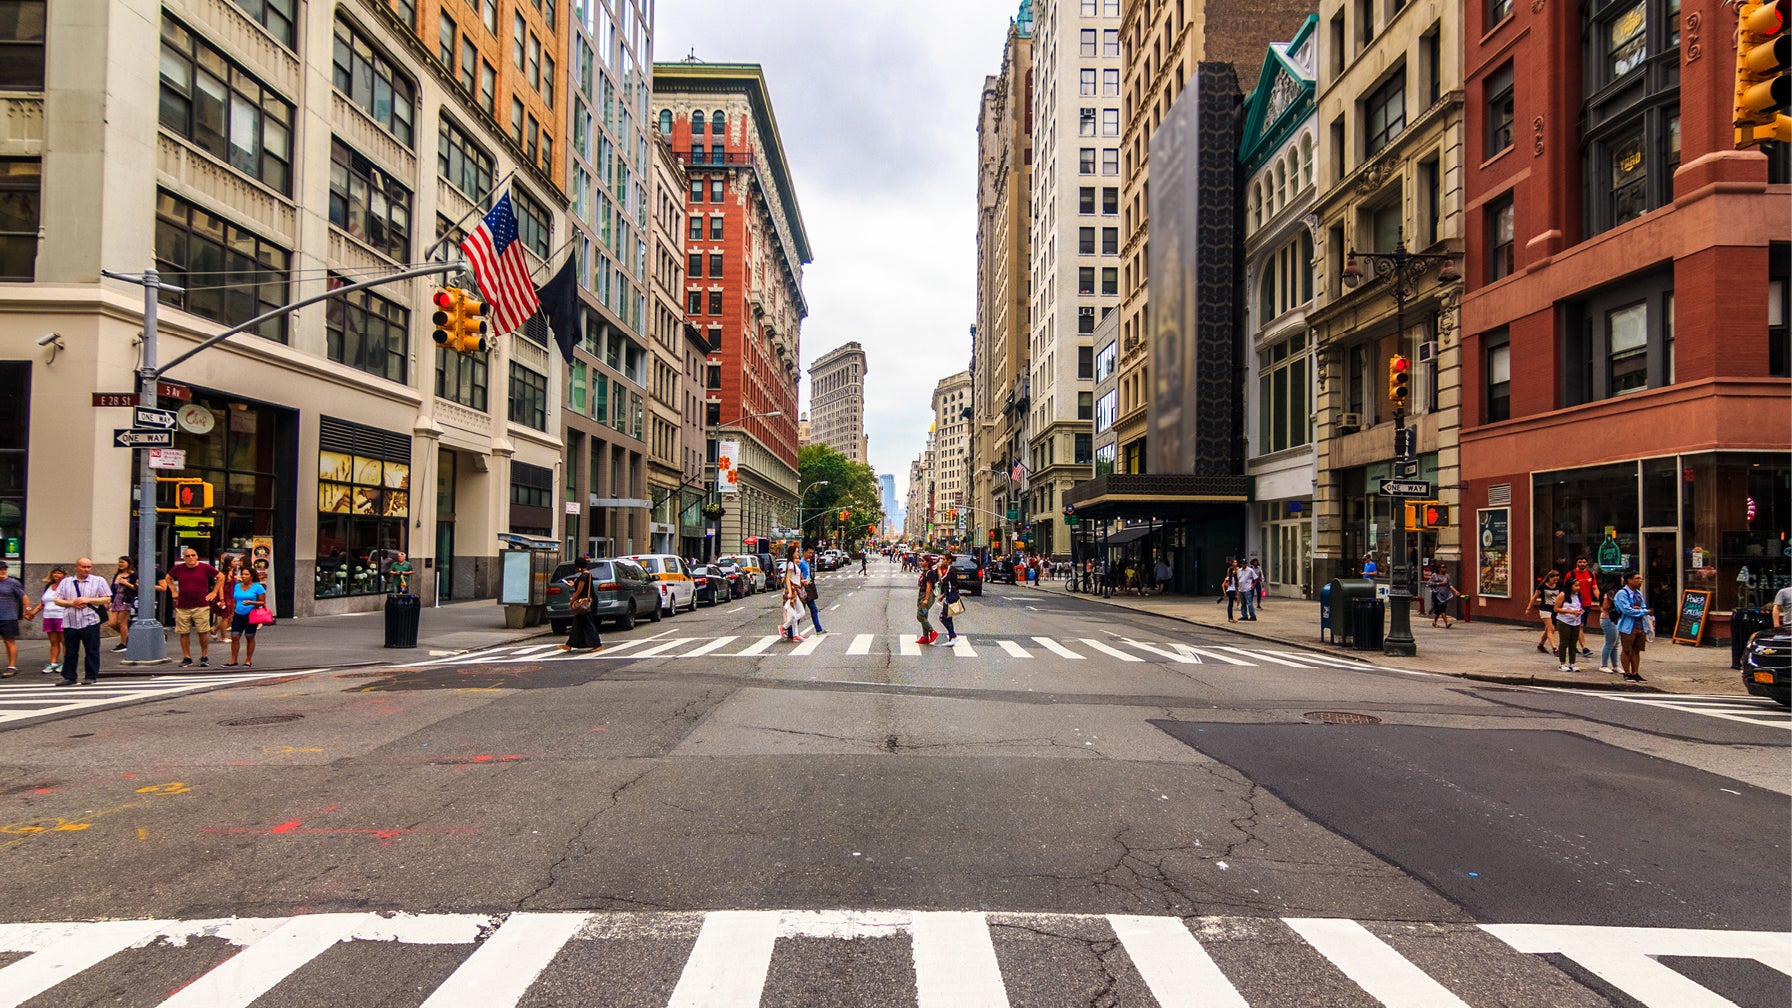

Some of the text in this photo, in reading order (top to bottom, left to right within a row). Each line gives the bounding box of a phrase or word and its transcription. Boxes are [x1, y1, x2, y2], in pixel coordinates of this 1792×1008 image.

[166, 386, 181, 397] 5 Av
[101, 396, 131, 406] E 28 St
[141, 412, 171, 424] ONE WAY
[122, 434, 165, 443] ONE WAY
[151, 449, 161, 457] NO
[1386, 484, 1424, 492] ONE WAY
[1686, 593, 1705, 605] POWER
